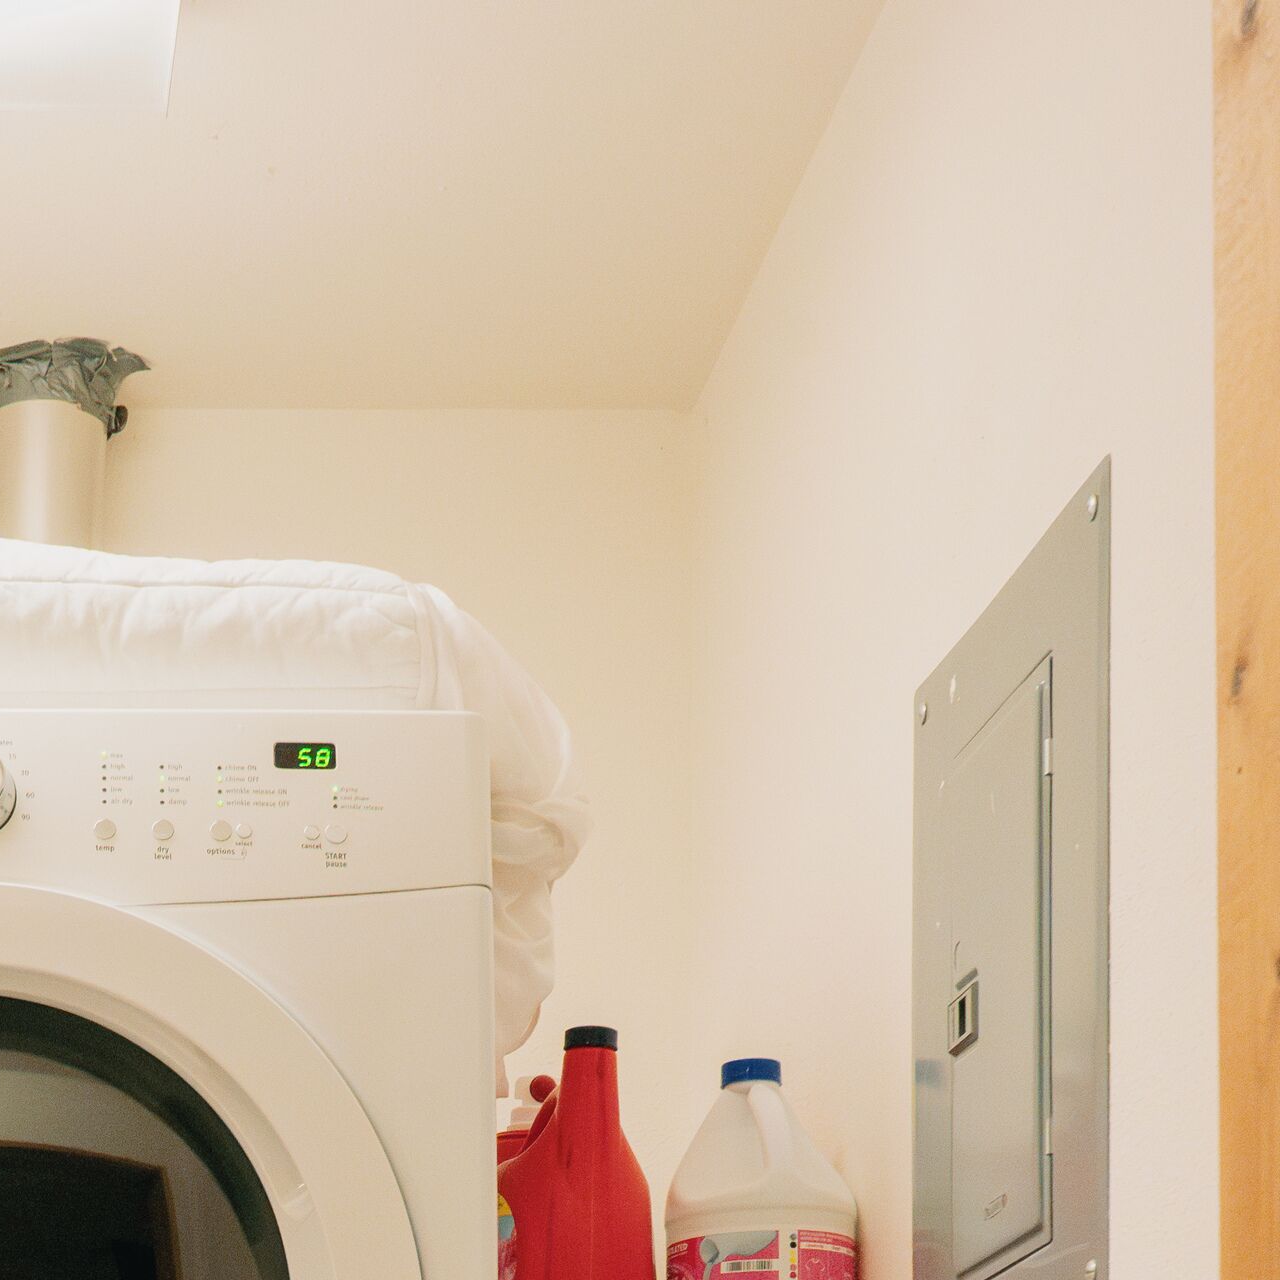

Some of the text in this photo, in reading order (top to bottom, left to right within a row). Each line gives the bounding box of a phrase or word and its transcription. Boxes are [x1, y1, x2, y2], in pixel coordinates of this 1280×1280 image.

[297, 747, 331, 768] 58
[95, 845, 115, 853] temp
[157, 846, 170, 854] dry
[206, 847, 236, 856] options
[154, 853, 172, 861] level
[325, 861, 348, 869] pause
